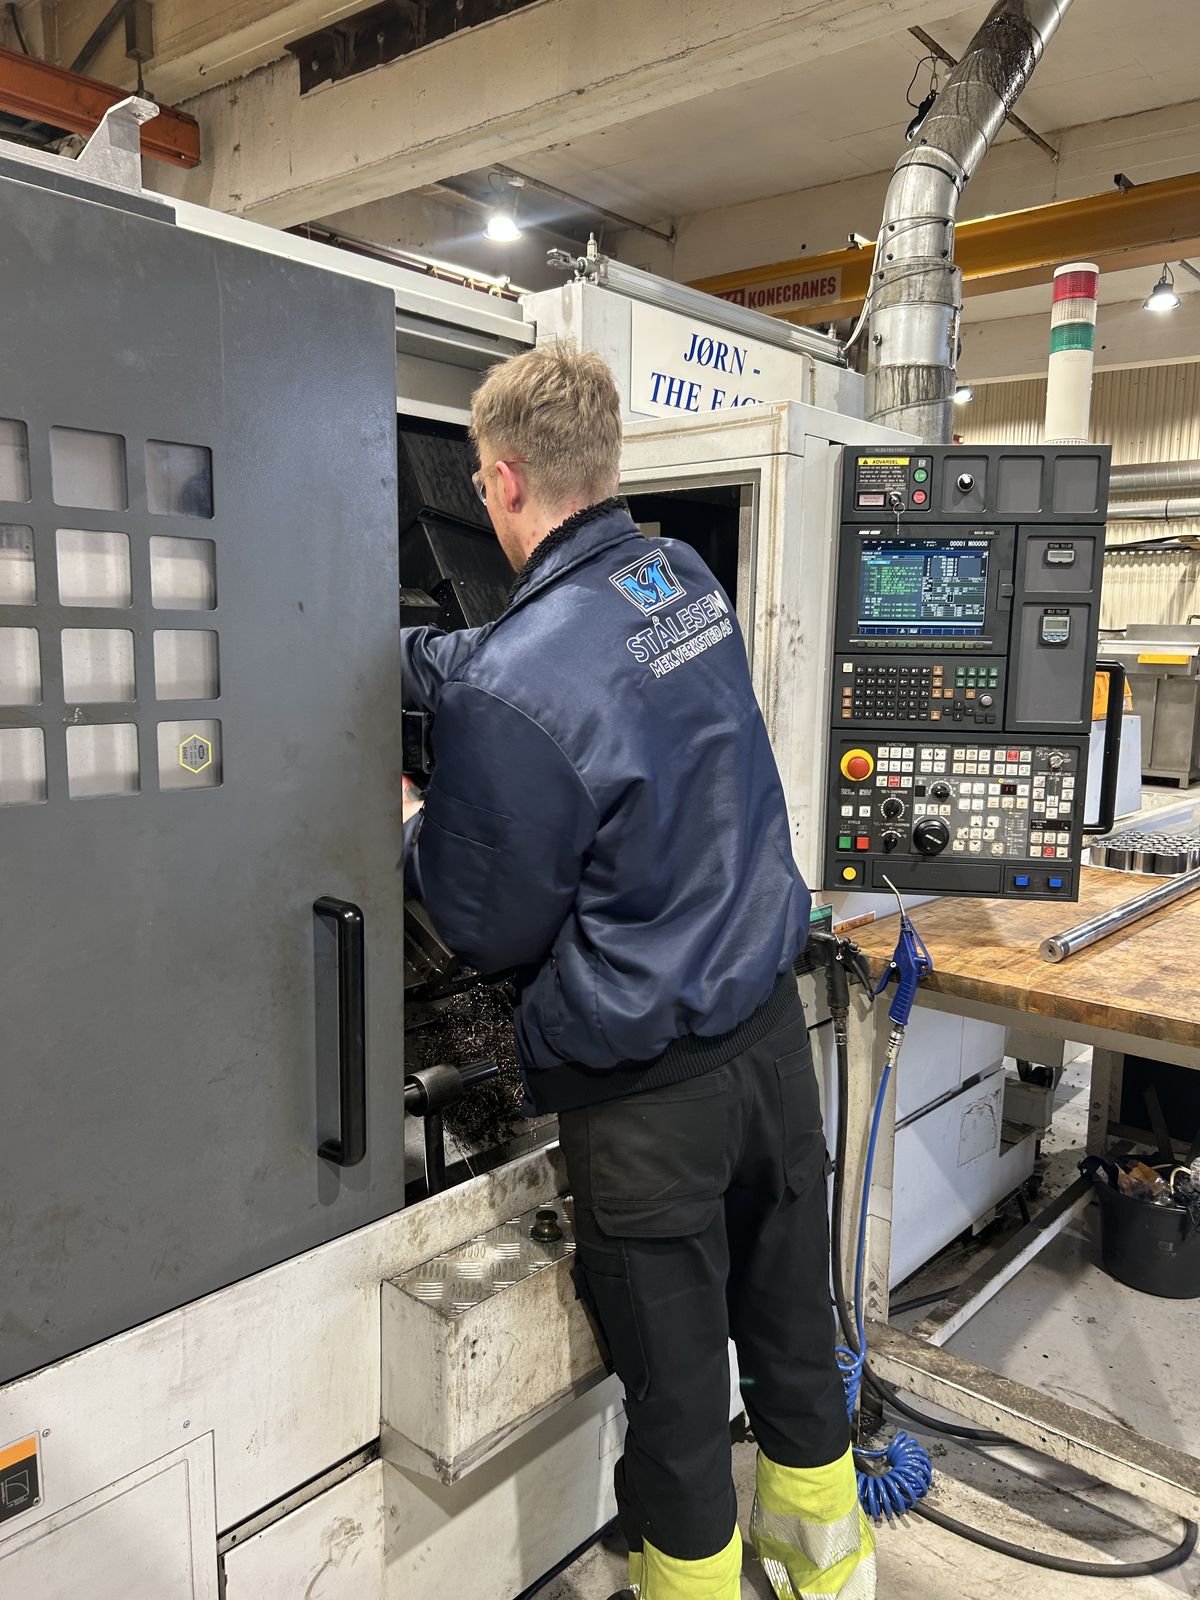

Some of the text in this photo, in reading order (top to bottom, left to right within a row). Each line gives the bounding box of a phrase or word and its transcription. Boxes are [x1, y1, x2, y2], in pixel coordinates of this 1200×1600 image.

[748, 276, 837, 309] KONECRANES
[683, 332, 748, 377] JØRN
[649, 372, 702, 413] THE
[626, 589, 729, 663] STÅLESEN
